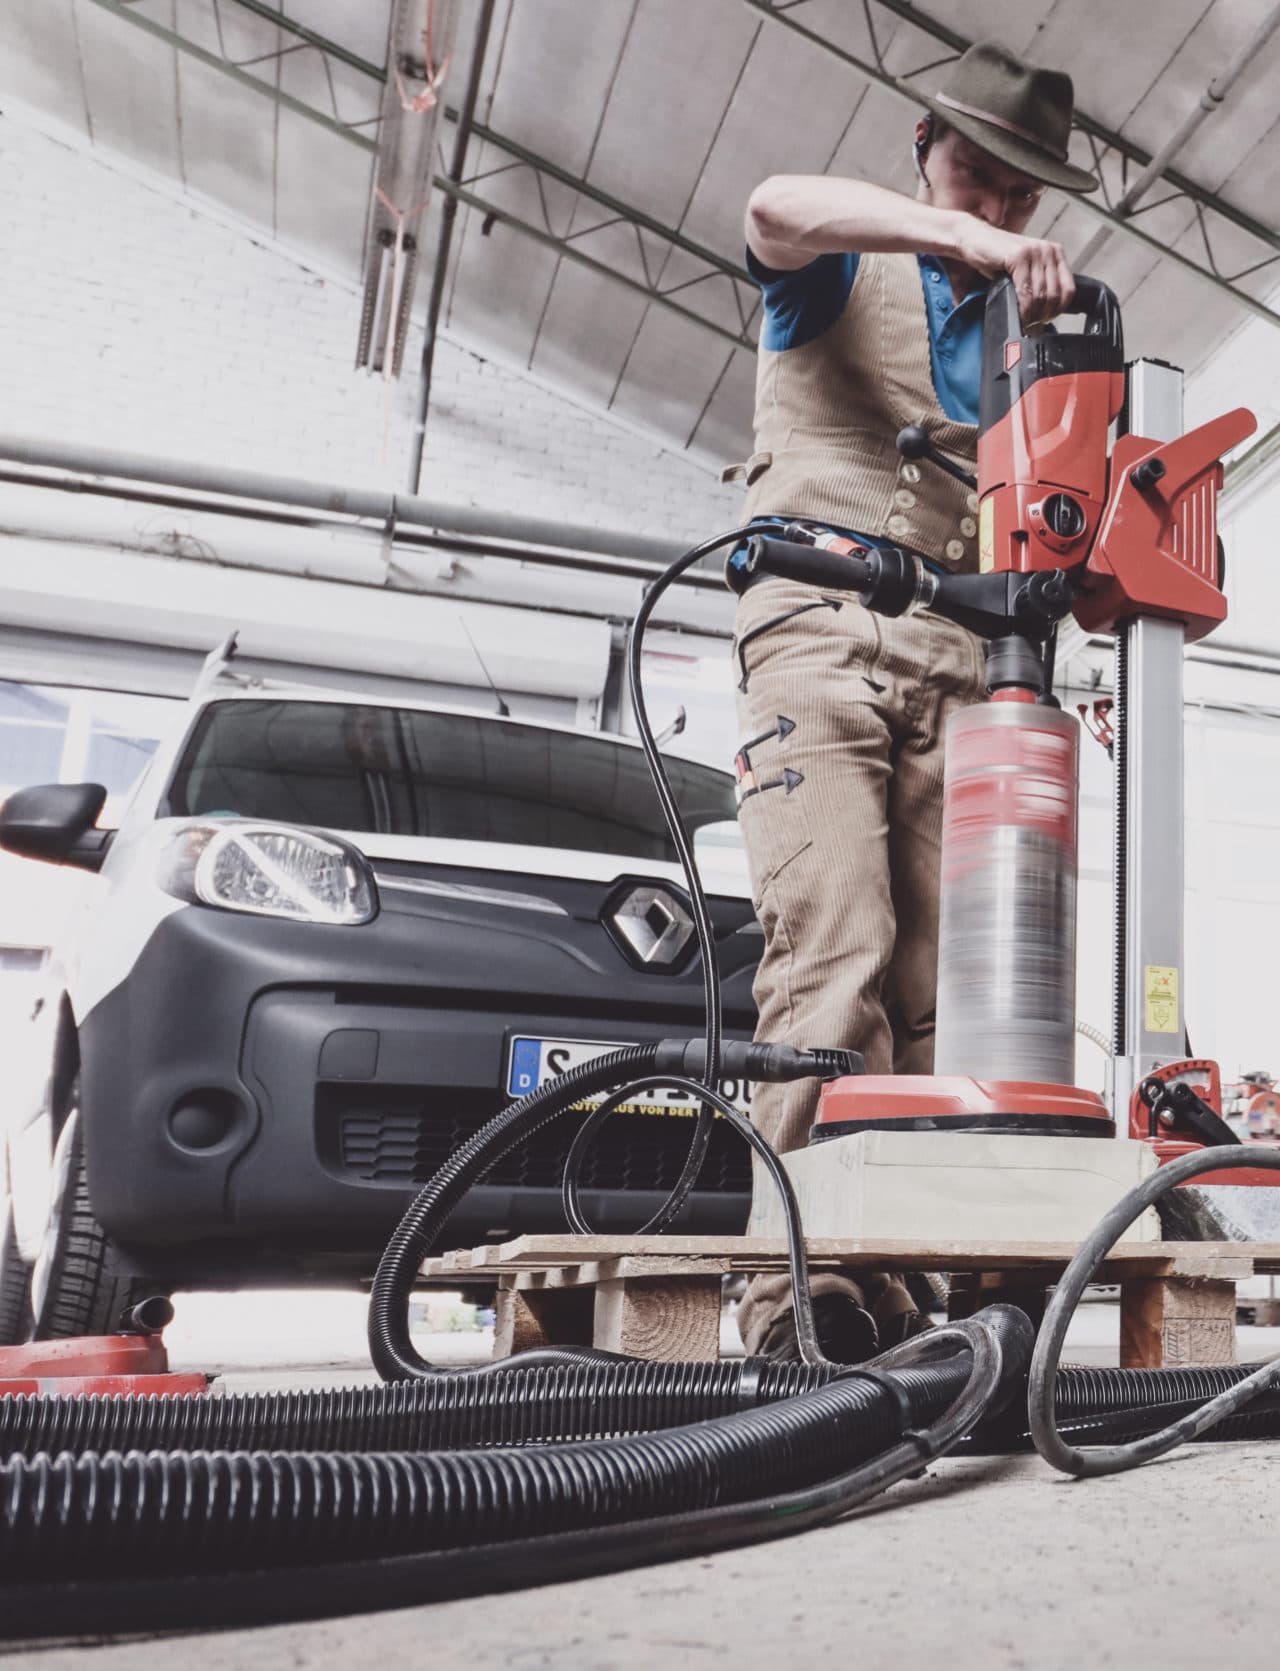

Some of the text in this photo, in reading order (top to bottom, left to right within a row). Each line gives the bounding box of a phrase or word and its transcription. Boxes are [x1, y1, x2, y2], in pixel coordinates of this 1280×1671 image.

[519, 1074, 531, 1088] D
[640, 1105, 665, 1116] VON
[668, 1107, 693, 1118] DER
